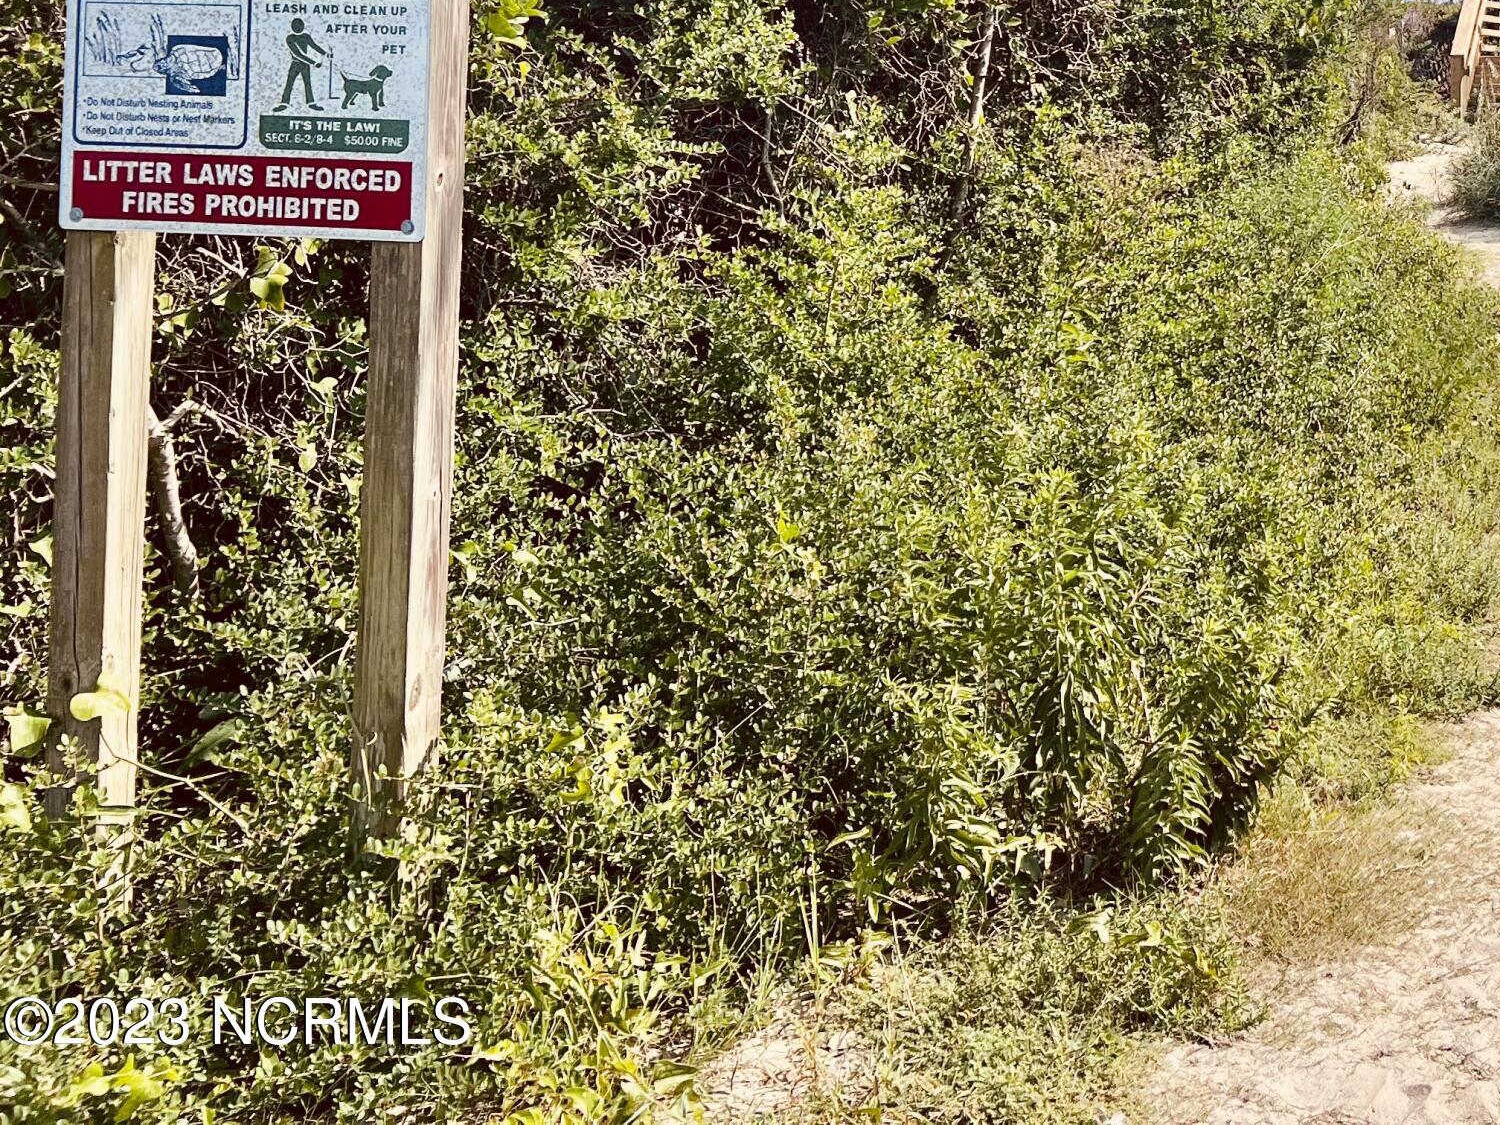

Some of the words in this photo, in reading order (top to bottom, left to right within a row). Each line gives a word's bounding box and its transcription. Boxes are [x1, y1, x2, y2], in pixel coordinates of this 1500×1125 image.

[266, 4, 307, 14] LEASH
[313, 5, 338, 14] AND
[344, 5, 386, 15] CLEAN
[392, 7, 407, 15] UP
[326, 24, 368, 34] AFTER
[373, 26, 406, 35] YOUR
[382, 45, 406, 54] PET
[87, 97, 98, 105] Do
[101, 98, 115, 106] Not
[116, 98, 146, 107] Disturb
[148, 99, 178, 110] Nesting
[180, 99, 213, 109] Animals
[87, 112, 98, 120] Do
[100, 112, 113, 120] Not
[116, 112, 145, 121] Disturb
[148, 113, 169, 122] Nests
[183, 114, 201, 123] Nest
[203, 115, 235, 124] Markers
[289, 120, 312, 131] IT'S
[316, 122, 341, 131] THE
[86, 126, 106, 136] Keep
[109, 126, 123, 135] Out
[126, 127, 133, 135] of
[136, 127, 164, 136] Closed
[166, 128, 188, 137] Areas
[265, 133, 292, 143] SECT.
[381, 137, 403, 147] FINE
[82, 160, 172, 184] LITTER
[184, 163, 253, 187] LAWS
[265, 166, 401, 192] ENFORCED
[122, 191, 194, 214] FIRES
[205, 194, 359, 221] PROHIBITED
